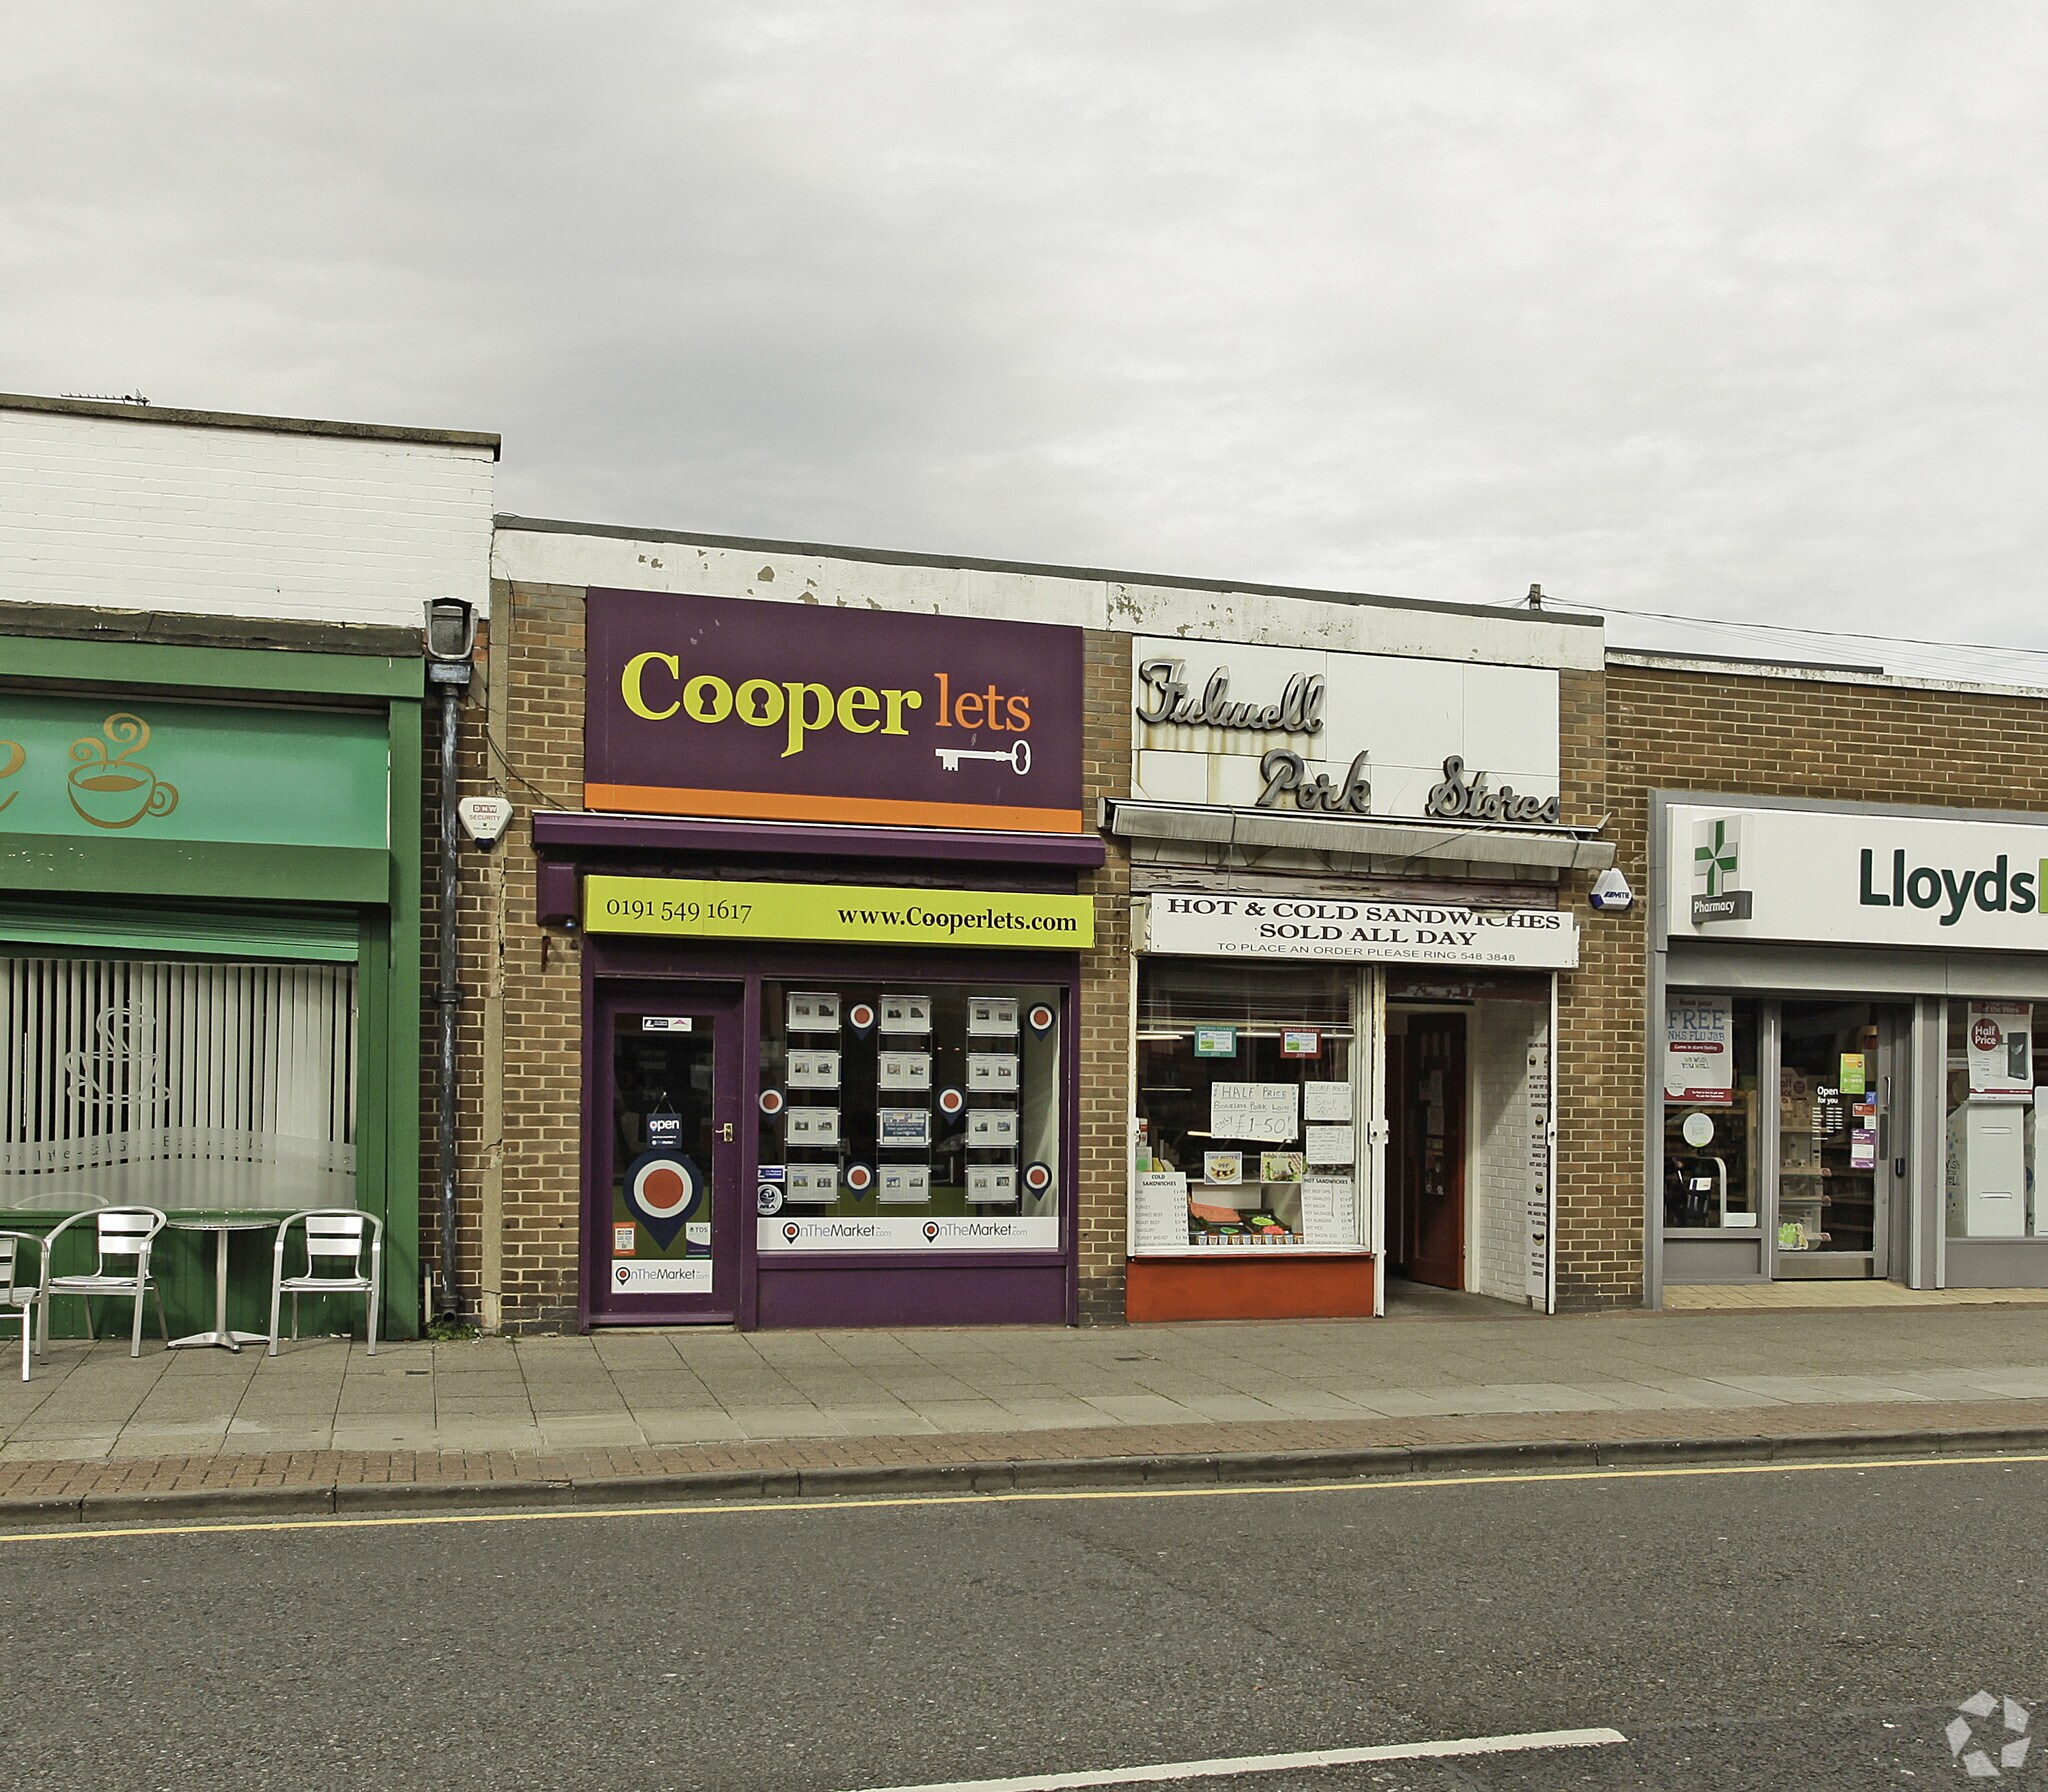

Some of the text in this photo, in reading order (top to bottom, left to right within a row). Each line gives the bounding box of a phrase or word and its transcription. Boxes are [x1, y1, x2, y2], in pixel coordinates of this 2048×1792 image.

[1136, 658, 1325, 733] Fulwell
[621, 652, 1031, 758] Cooper lets
[1255, 749, 1559, 823] Pork Stores
[1860, 849, 2035, 926] Lloyds
[1167, 899, 1560, 929] HOT & COLD SANDWICHES
[1694, 901, 1735, 913] Pharmacy
[606, 898, 1077, 935] 0191 549 1617 www.Cooperlets.com
[1260, 923, 1477, 946] SOLD ALL DAY
[1241, 944, 1287, 953] PLACE
[1290, 946, 1309, 954] AN
[1314, 946, 1362, 955] ORDER
[1368, 949, 1420, 958] PLEASE
[1424, 950, 1456, 959] RING
[1461, 952, 1482, 960] 548
[1487, 953, 1515, 961] 3848
[1668, 1009, 1725, 1030] FREE
[1668, 1031, 1687, 1040] NHS
[1690, 1032, 1706, 1040] FLU
[1975, 1026, 1996, 1036] Half
[1975, 1036, 1996, 1044] Price
[1222, 1086, 1287, 1098] HALF PRICE
[1817, 1086, 1838, 1097] Open
[1250, 1101, 1267, 1110] PORK
[650, 1120, 679, 1132] open
